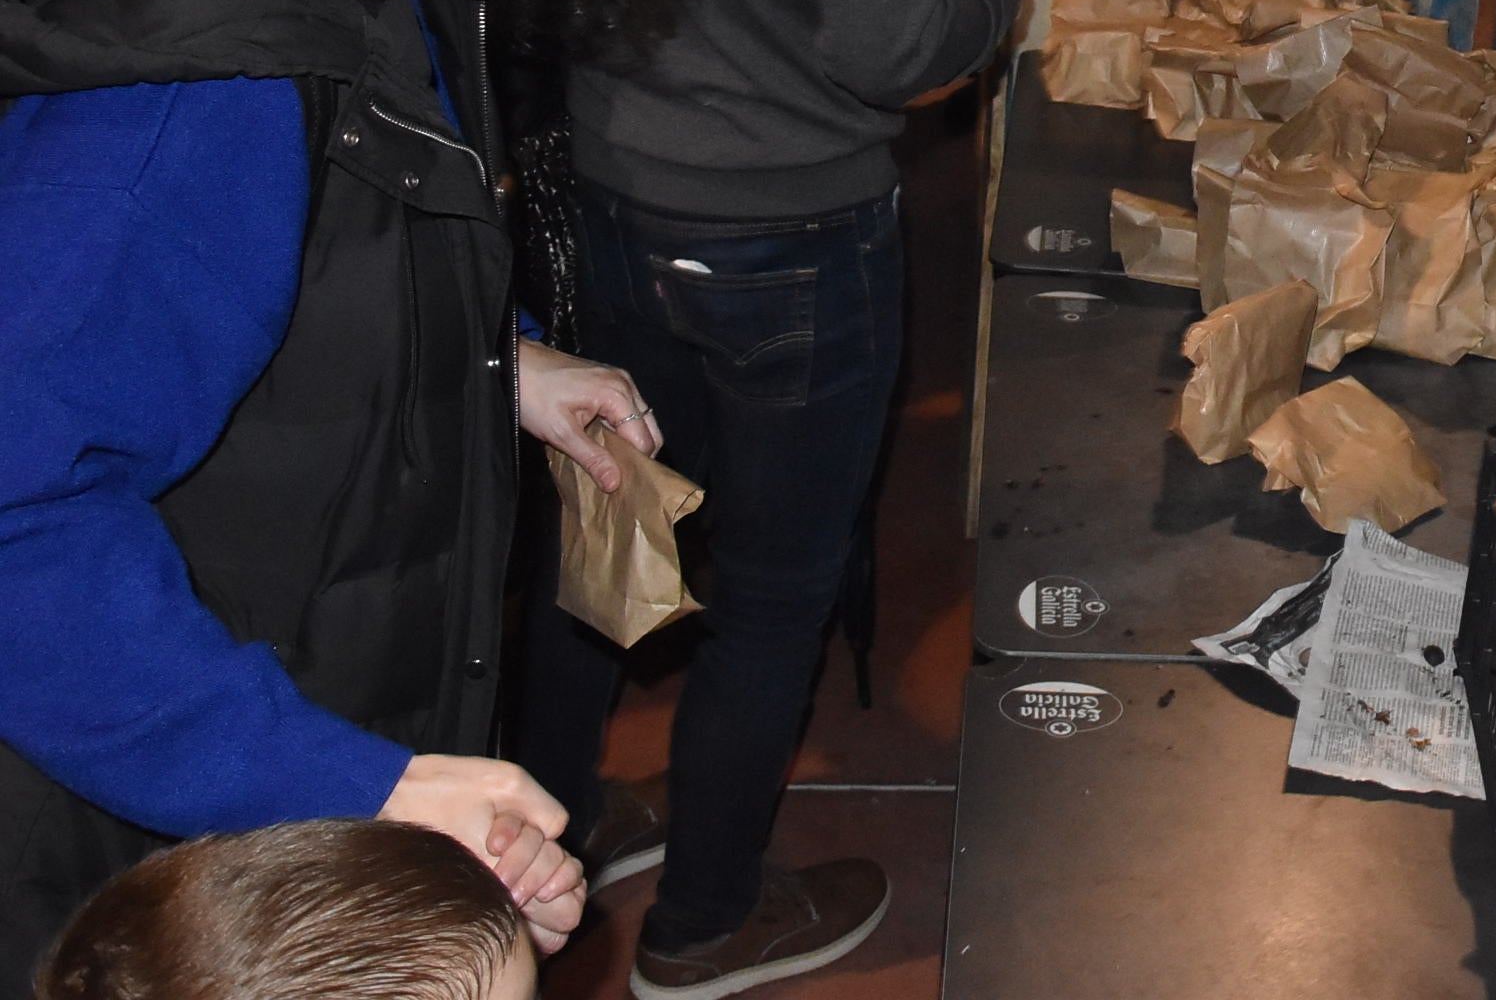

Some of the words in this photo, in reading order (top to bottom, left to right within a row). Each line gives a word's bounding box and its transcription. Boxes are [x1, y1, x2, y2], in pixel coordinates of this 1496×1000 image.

[1041, 586, 1061, 625] Galicia
[1062, 586, 1082, 628] Estrella
[1020, 706, 1102, 722] Estrella
[1025, 693, 1100, 709] Galicia
